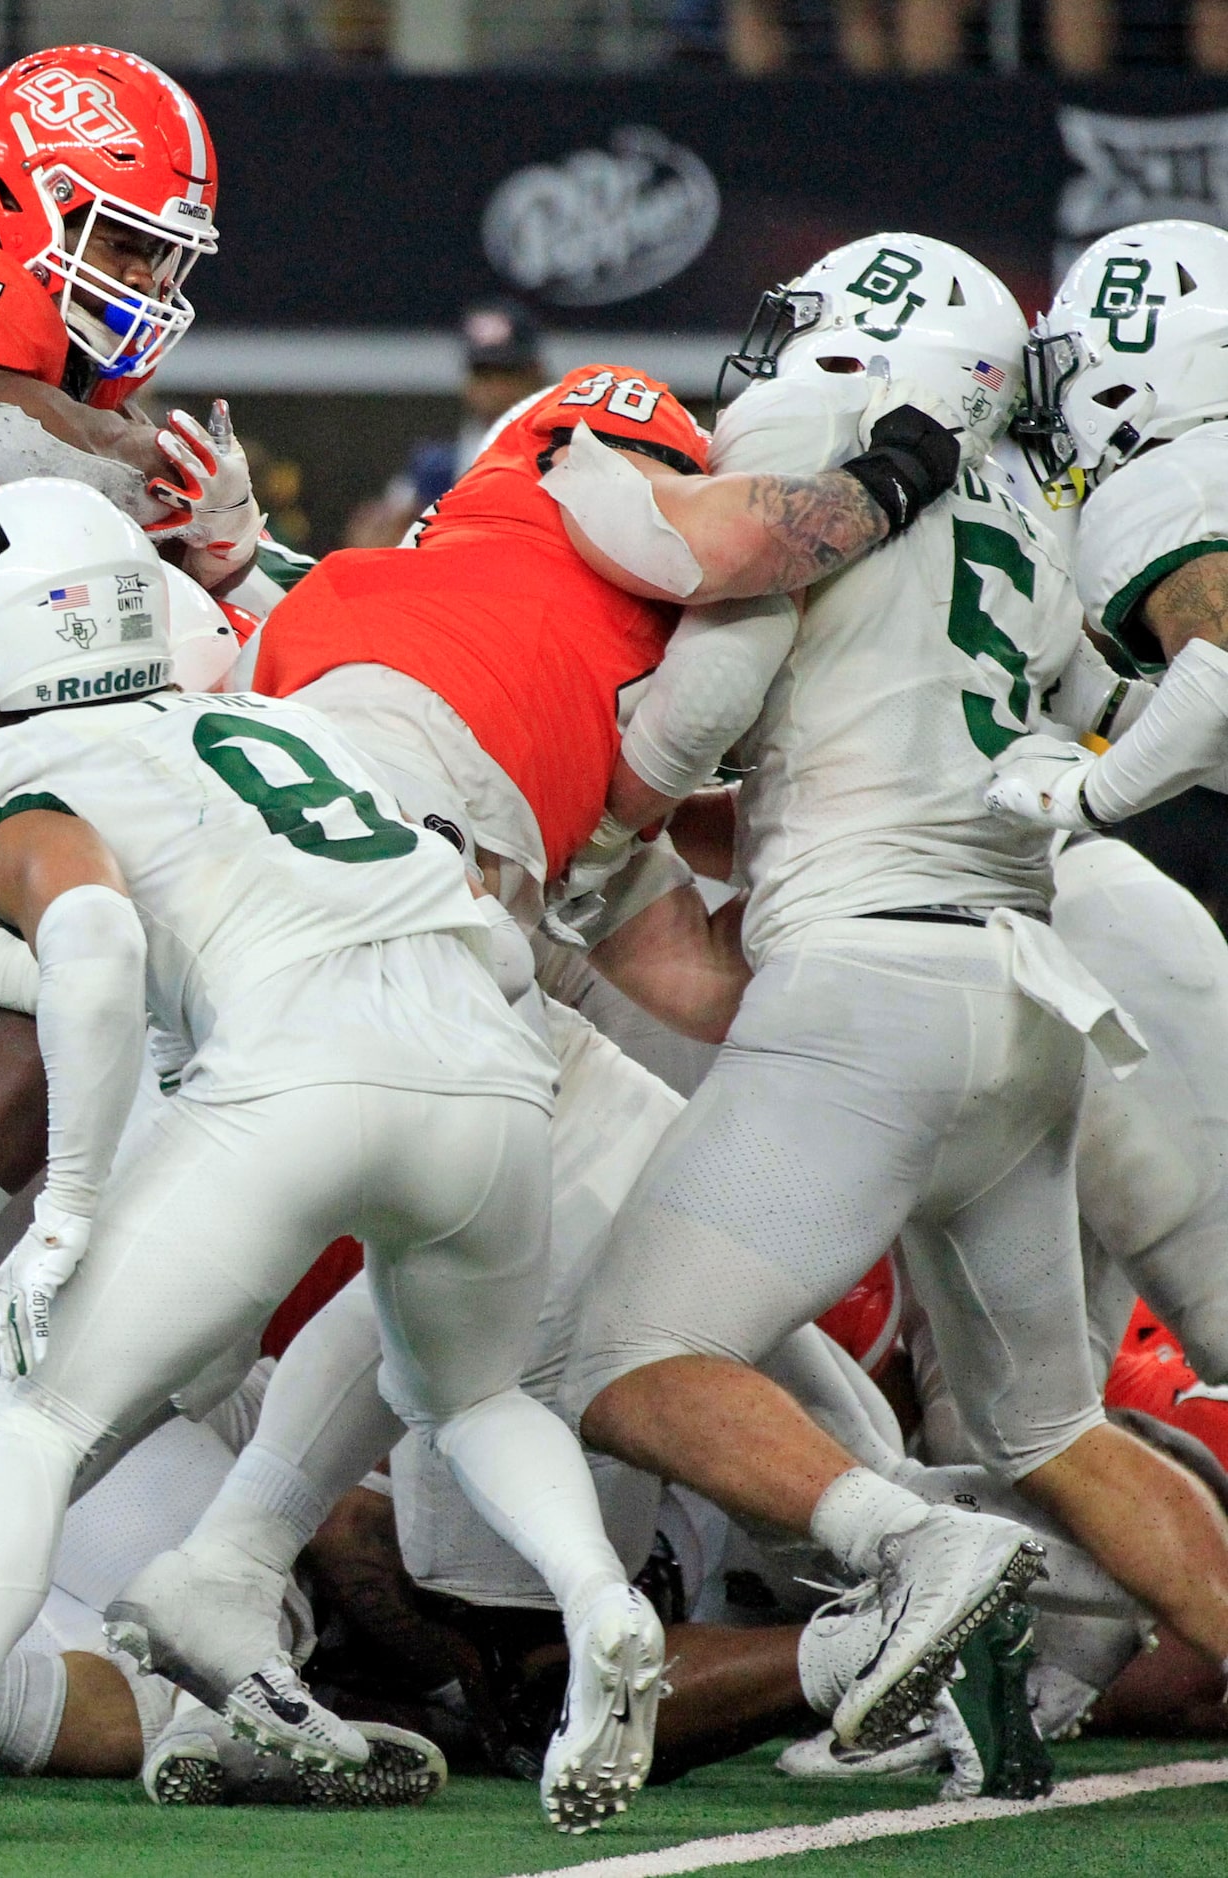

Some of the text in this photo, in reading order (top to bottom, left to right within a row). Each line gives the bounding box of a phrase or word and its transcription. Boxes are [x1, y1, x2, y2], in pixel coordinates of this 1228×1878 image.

[1091, 257, 1167, 354] BU
[117, 597, 143, 612] UNITY
[57, 662, 162, 701] Riddell
[192, 712, 419, 863] 8
[33, 1290, 50, 1338] BAYLOR
